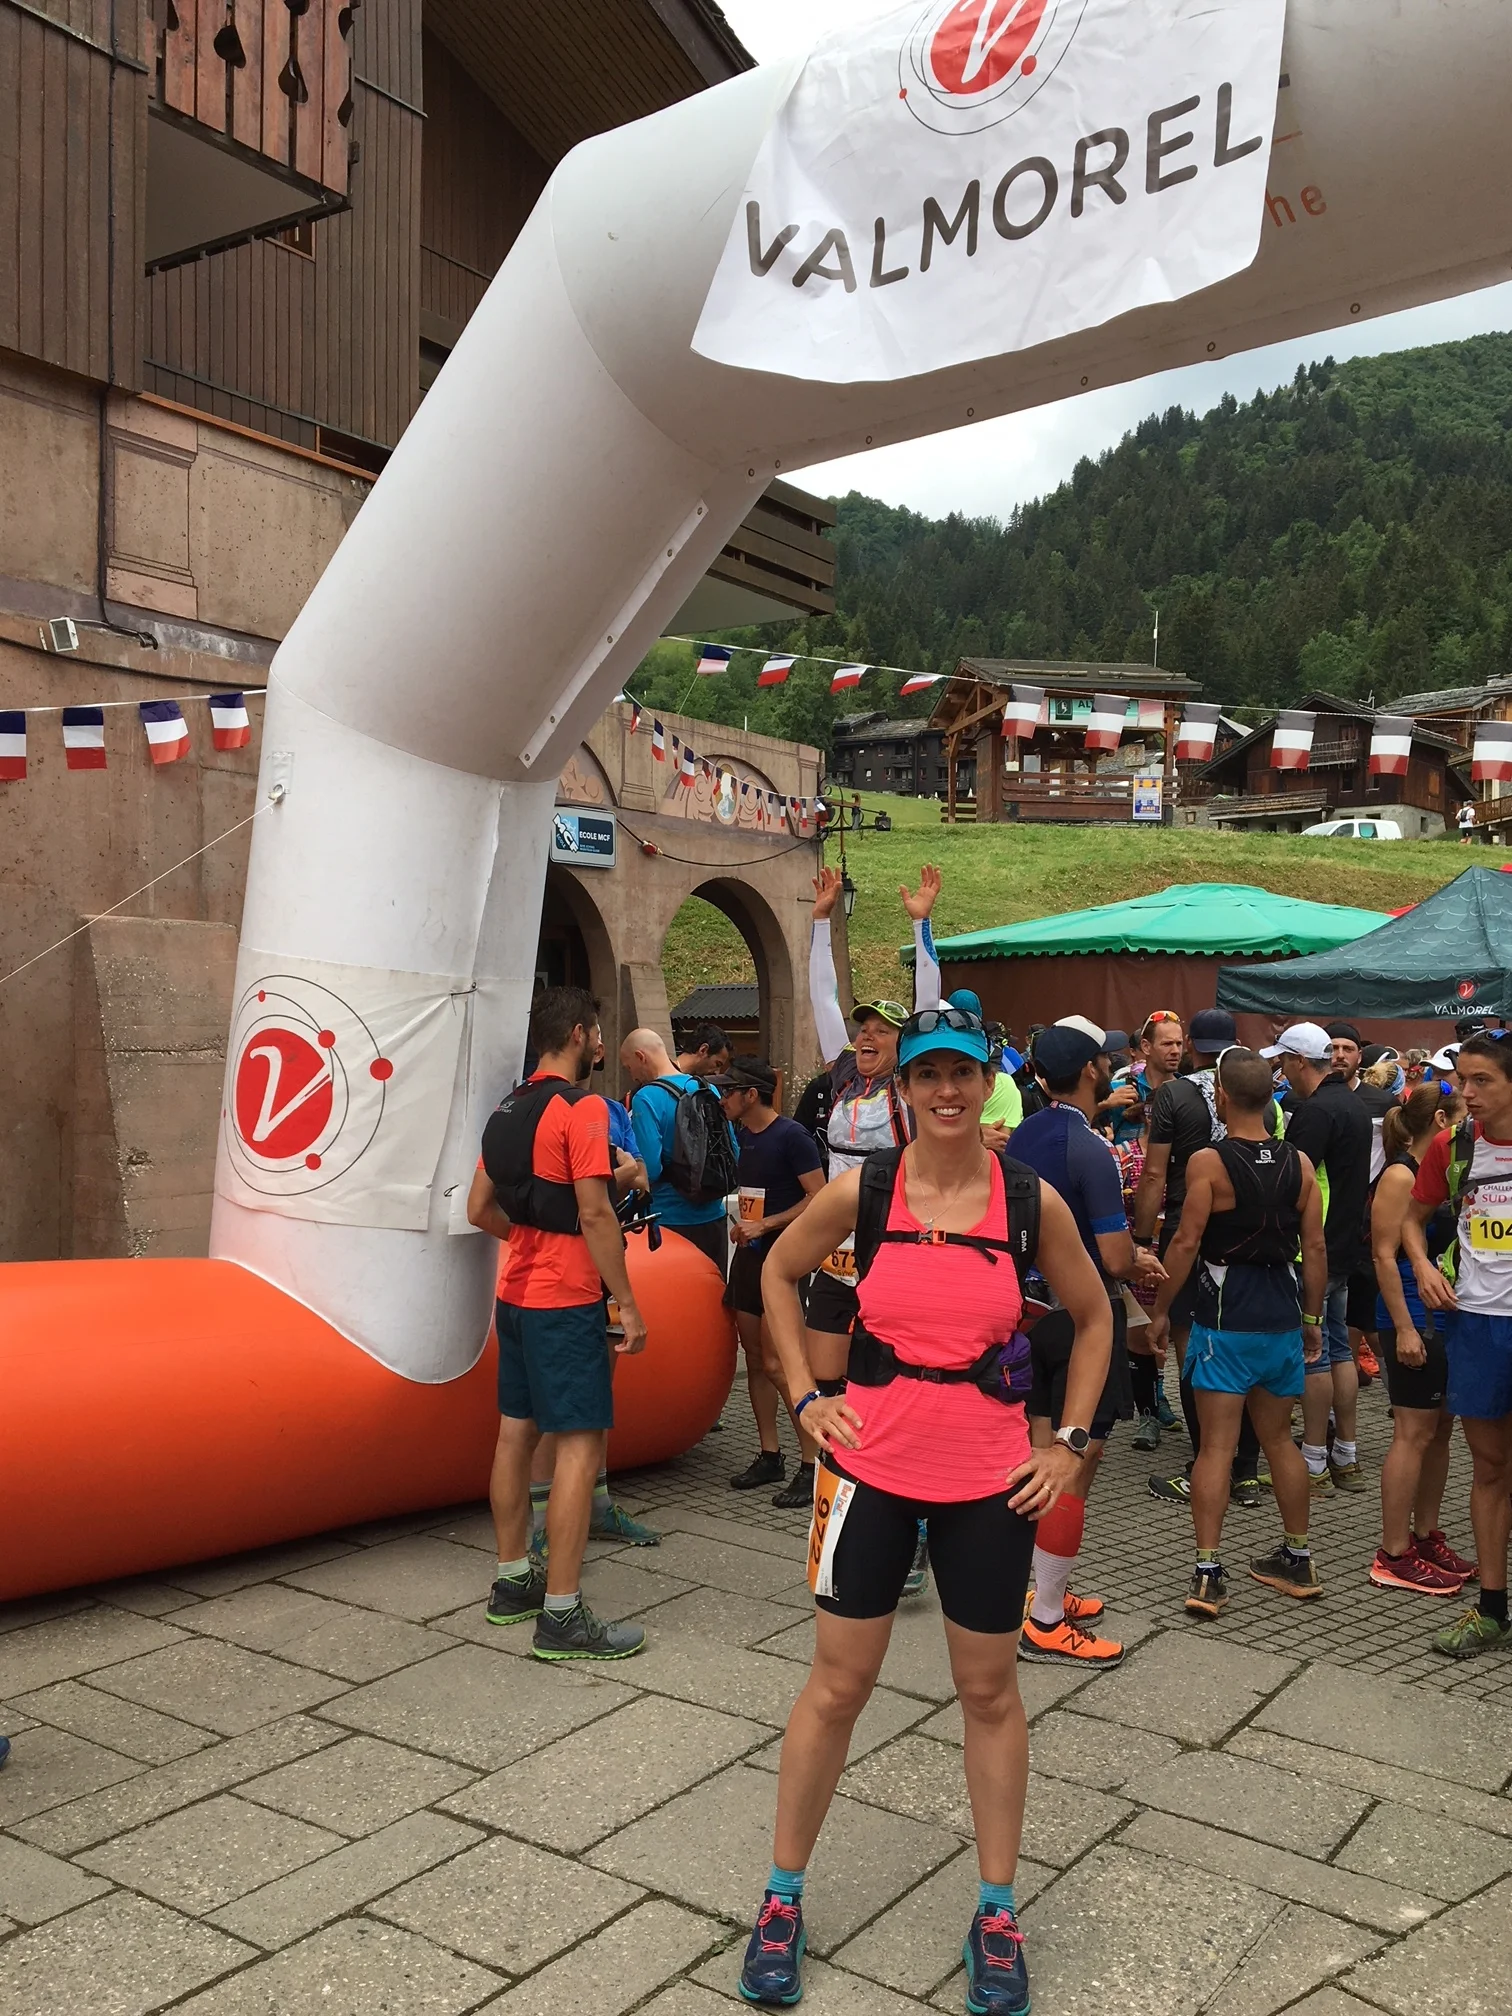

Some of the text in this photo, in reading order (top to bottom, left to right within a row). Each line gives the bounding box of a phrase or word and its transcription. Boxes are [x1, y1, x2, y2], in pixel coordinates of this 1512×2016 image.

[746, 82, 1263, 293] VALMOREL
[579, 831, 611, 841] ECOLE MCF
[1434, 1005, 1495, 1015] VALMOREL
[1482, 1193, 1508, 1204] SUD
[1020, 1229, 1028, 1252] OMM
[810, 1494, 831, 1565] 972
